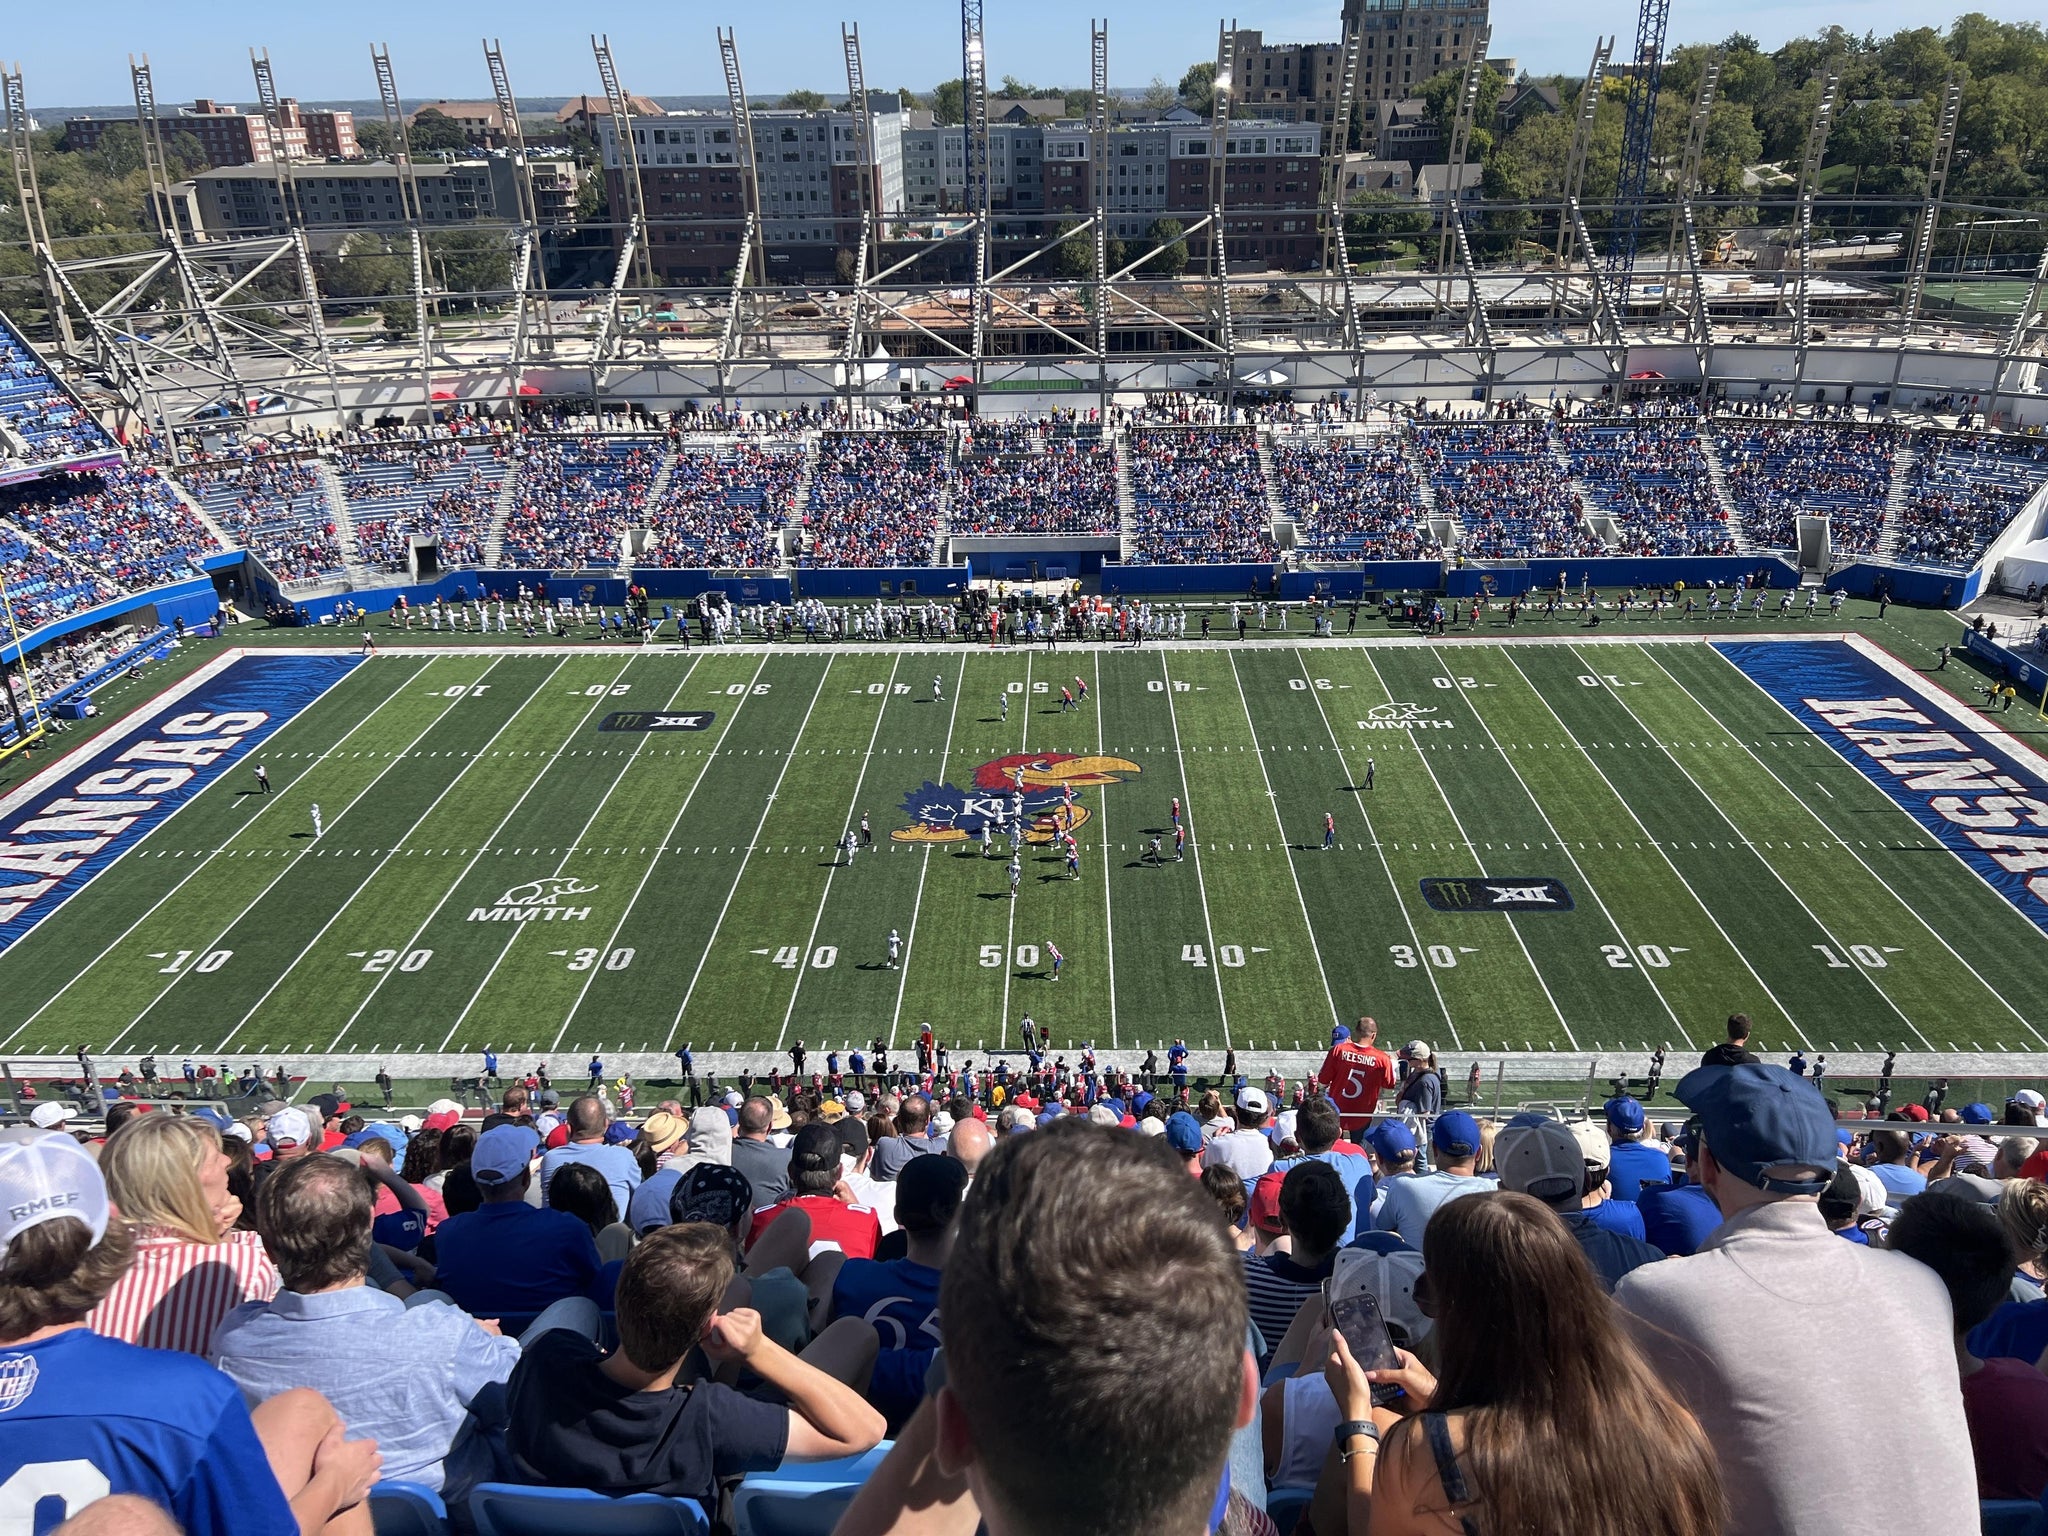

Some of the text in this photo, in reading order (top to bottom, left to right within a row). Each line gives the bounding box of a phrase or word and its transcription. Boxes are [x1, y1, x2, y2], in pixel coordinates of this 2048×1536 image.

[1356, 719, 1455, 729] MMTH
[1802, 697, 2048, 906] KANSA
[466, 907, 592, 921] MMTH
[158, 950, 234, 973] 10
[361, 949, 434, 972] 20
[566, 948, 636, 971] 30
[772, 945, 839, 968] 40
[979, 944, 1040, 967] 50
[1181, 944, 1246, 967] 40
[1389, 945, 1458, 968] 30
[1600, 944, 1672, 968] 20
[1812, 944, 1889, 968] 10
[1342, 1050, 1377, 1067] REESING
[1341, 1068, 1366, 1099] 5
[8, 1192, 80, 1221] RMEF
